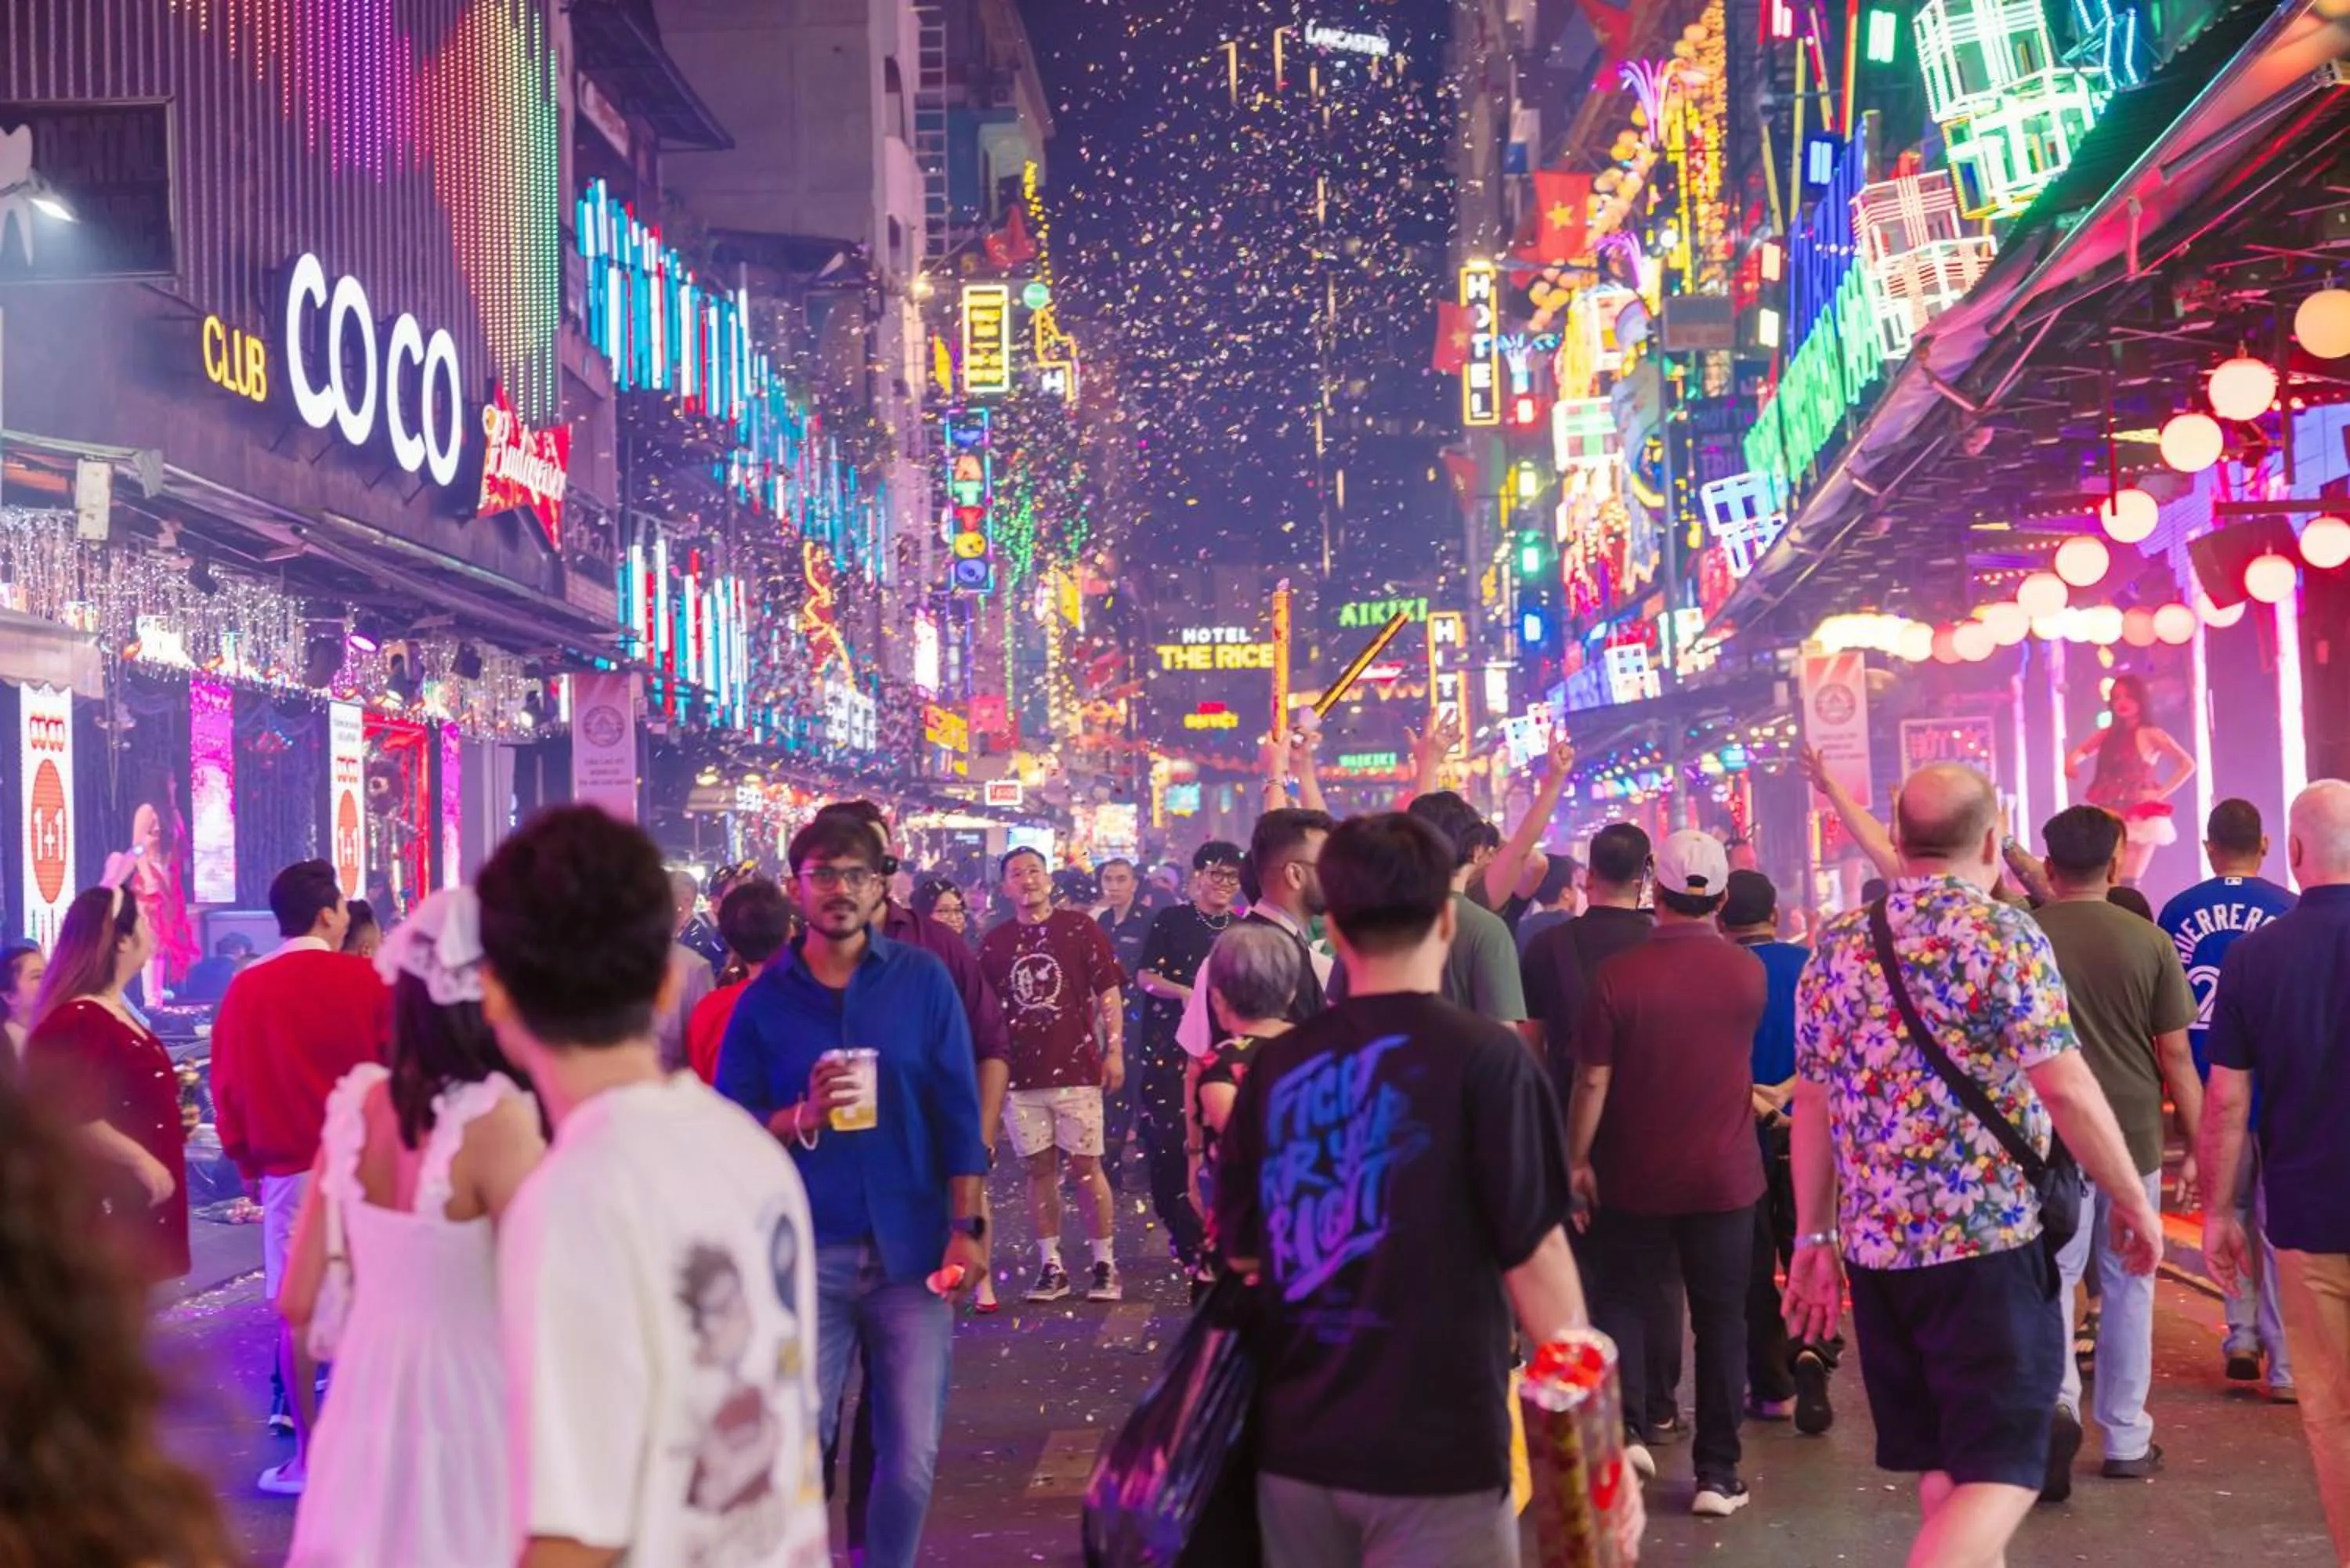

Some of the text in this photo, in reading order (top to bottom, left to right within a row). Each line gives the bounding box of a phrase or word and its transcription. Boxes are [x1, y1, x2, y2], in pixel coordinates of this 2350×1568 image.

[203, 315, 268, 402] CLUB
[1466, 273, 1492, 418] HOTEL
[1155, 643, 1274, 670] THE RICE
[1182, 627, 1252, 644] HOTEL
[34, 807, 64, 862] 1+1
[338, 826, 359, 868] 1+1
